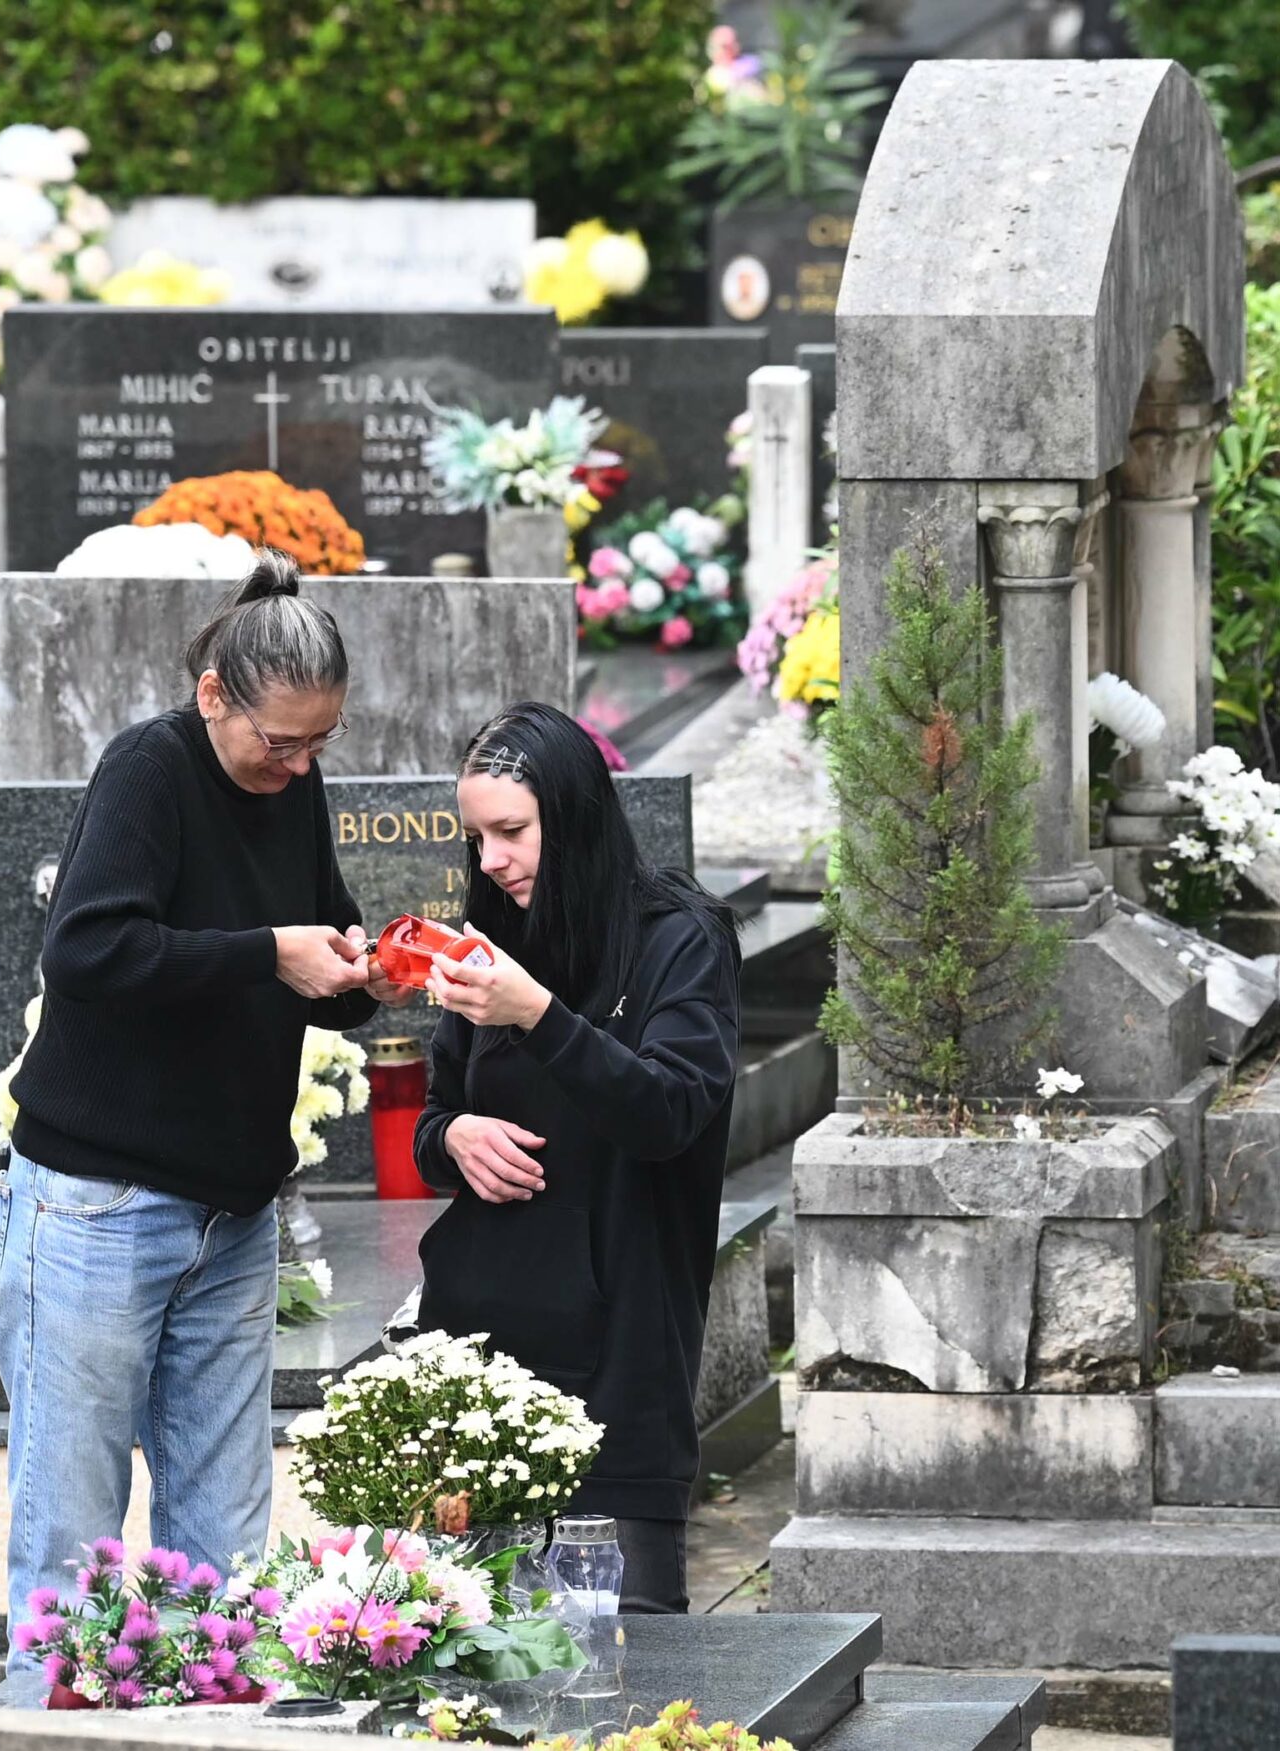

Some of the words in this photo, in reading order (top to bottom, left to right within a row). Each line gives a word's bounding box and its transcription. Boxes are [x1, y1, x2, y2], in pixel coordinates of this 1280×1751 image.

[198, 336, 351, 362] OBITELJI
[78, 413, 174, 438] MARIJA
[338, 810, 467, 845] BIOND
